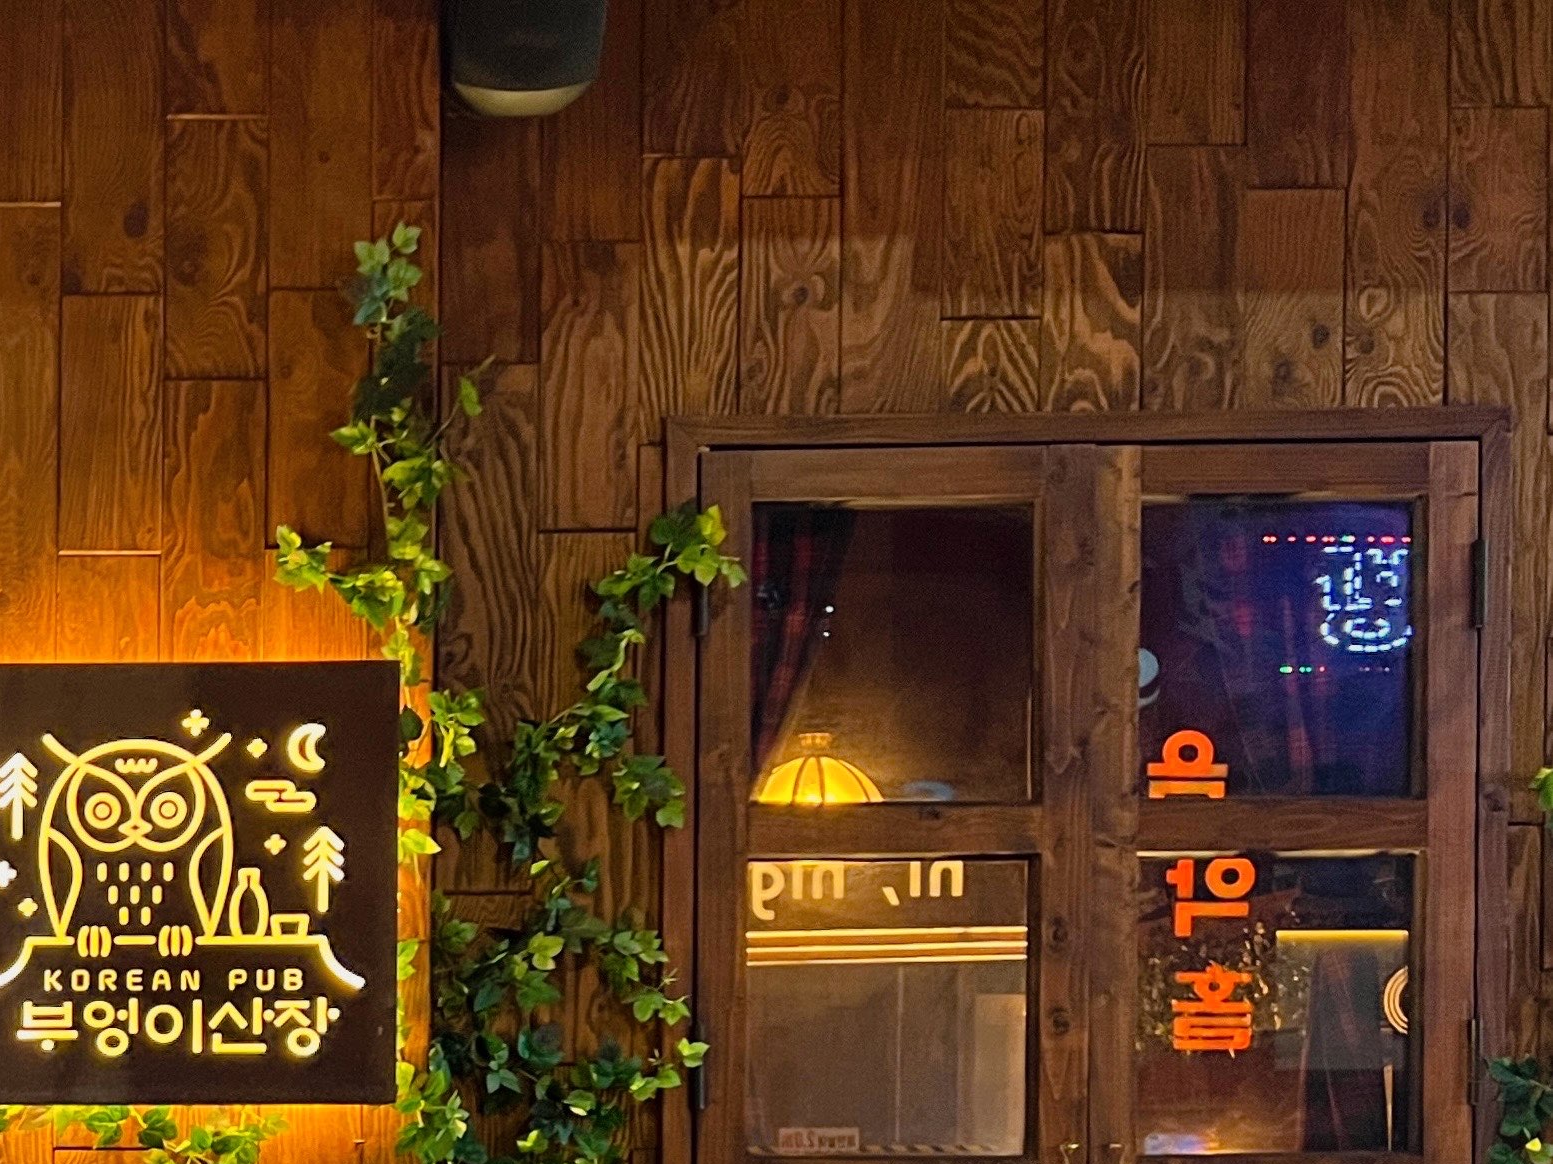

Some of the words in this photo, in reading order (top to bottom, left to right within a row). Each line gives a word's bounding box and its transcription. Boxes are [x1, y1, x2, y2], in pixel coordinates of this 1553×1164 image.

[43, 968, 202, 992] KOREAN
[227, 968, 305, 990] PUB
[16, 996, 341, 1057] 부엉이산장
